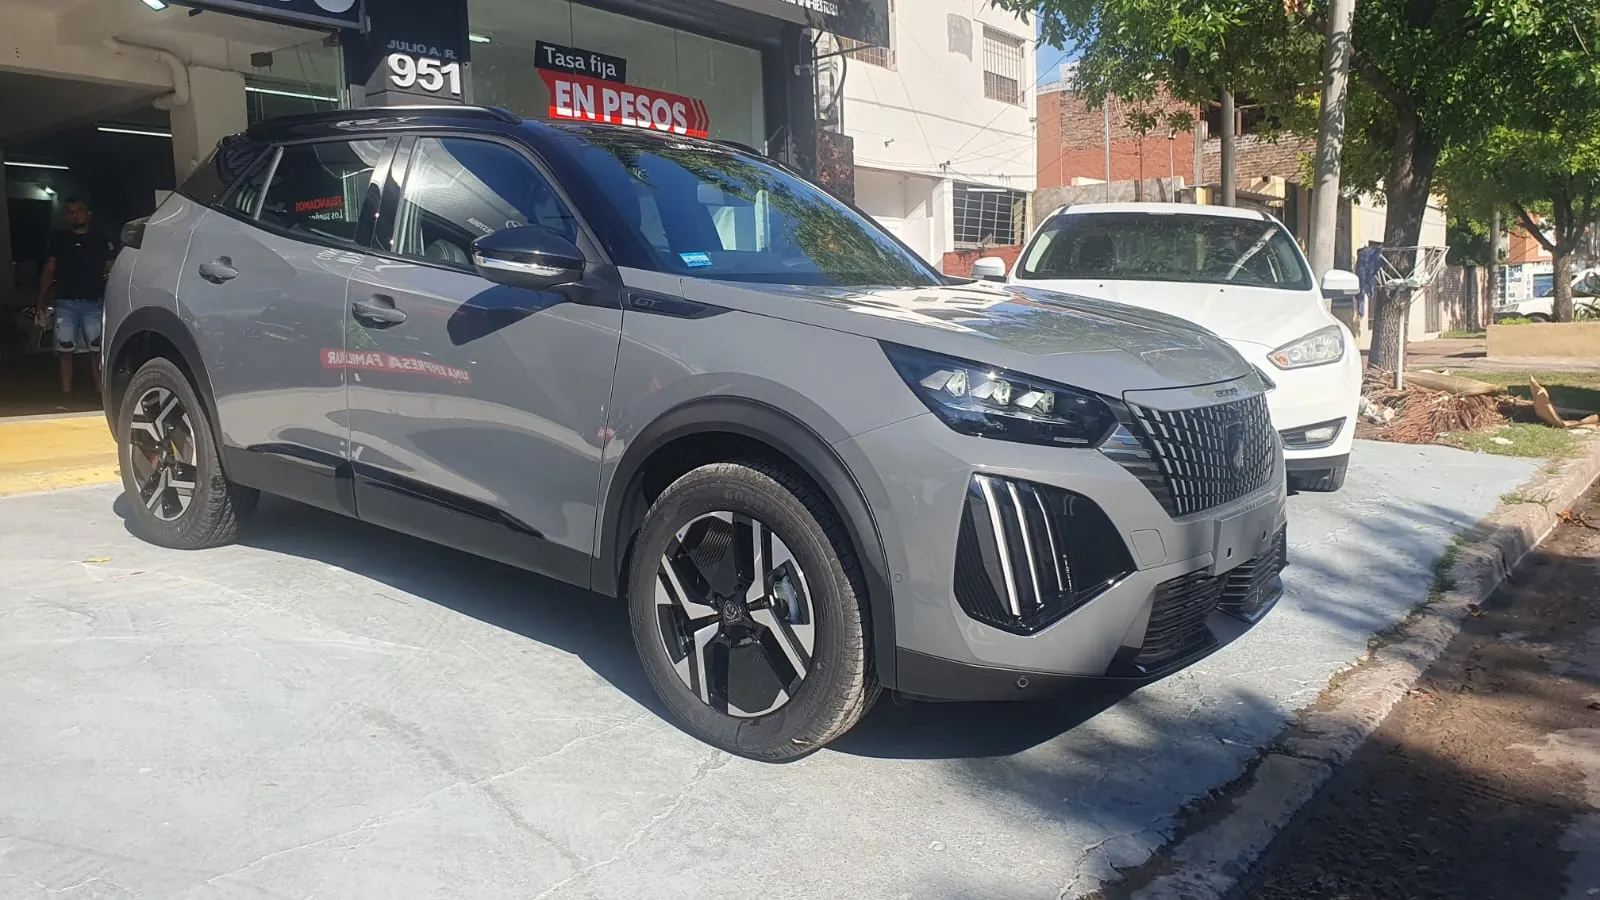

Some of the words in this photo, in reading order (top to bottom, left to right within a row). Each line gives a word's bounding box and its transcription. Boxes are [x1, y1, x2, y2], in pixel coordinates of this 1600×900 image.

[387, 40, 427, 54] JULIO
[428, 46, 442, 57] A.
[444, 48, 458, 60] R.
[543, 46, 586, 70] Tasa
[589, 54, 617, 79] fija
[387, 53, 461, 94] 951
[554, 79, 596, 120] EN
[602, 87, 688, 135] PESOS
[634, 297, 662, 309] GT
